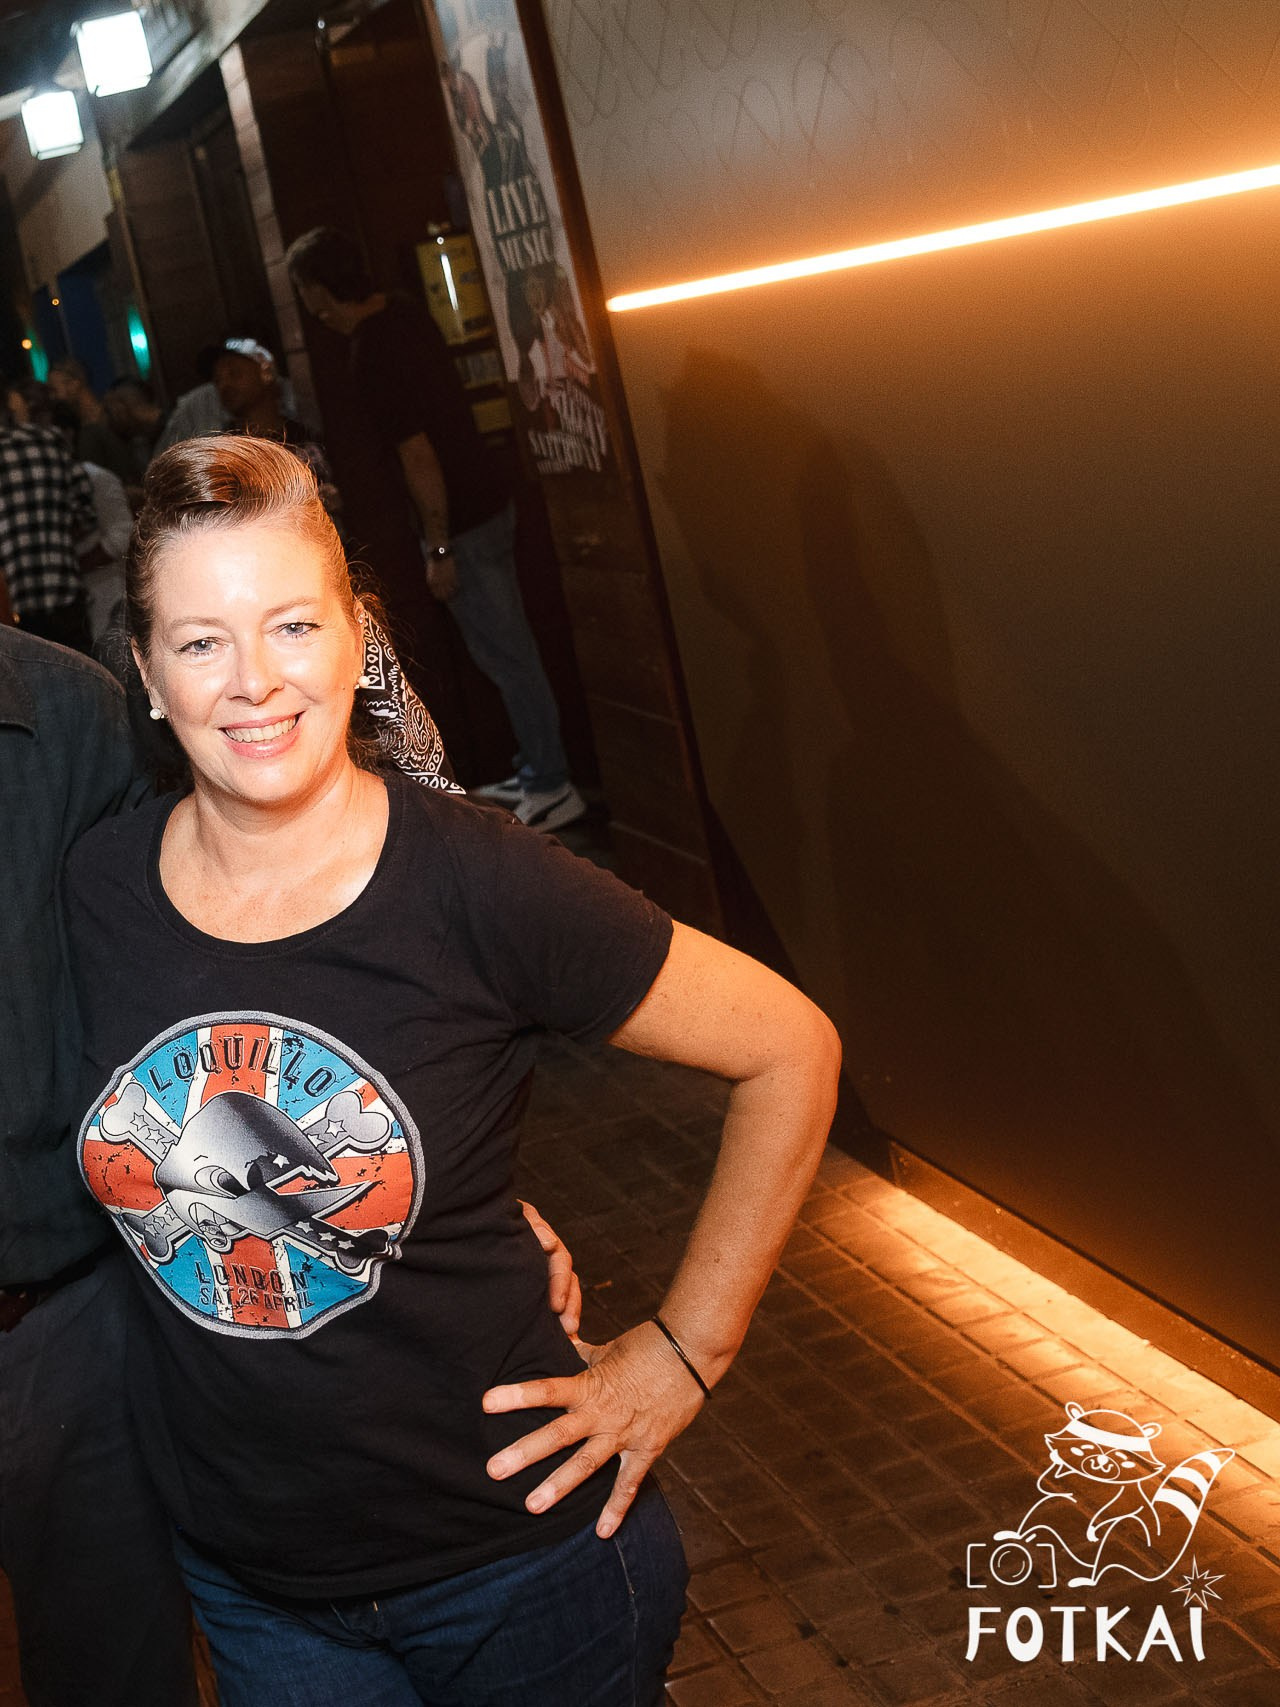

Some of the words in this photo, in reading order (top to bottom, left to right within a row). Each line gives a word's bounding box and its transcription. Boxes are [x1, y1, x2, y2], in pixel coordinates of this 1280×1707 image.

[487, 175, 547, 234] LIVE
[498, 227, 554, 271] MUSIC
[148, 1035, 337, 1098] LOQUILLO
[194, 1260, 309, 1294] LONDON
[263, 1290, 316, 1312] APRIL
